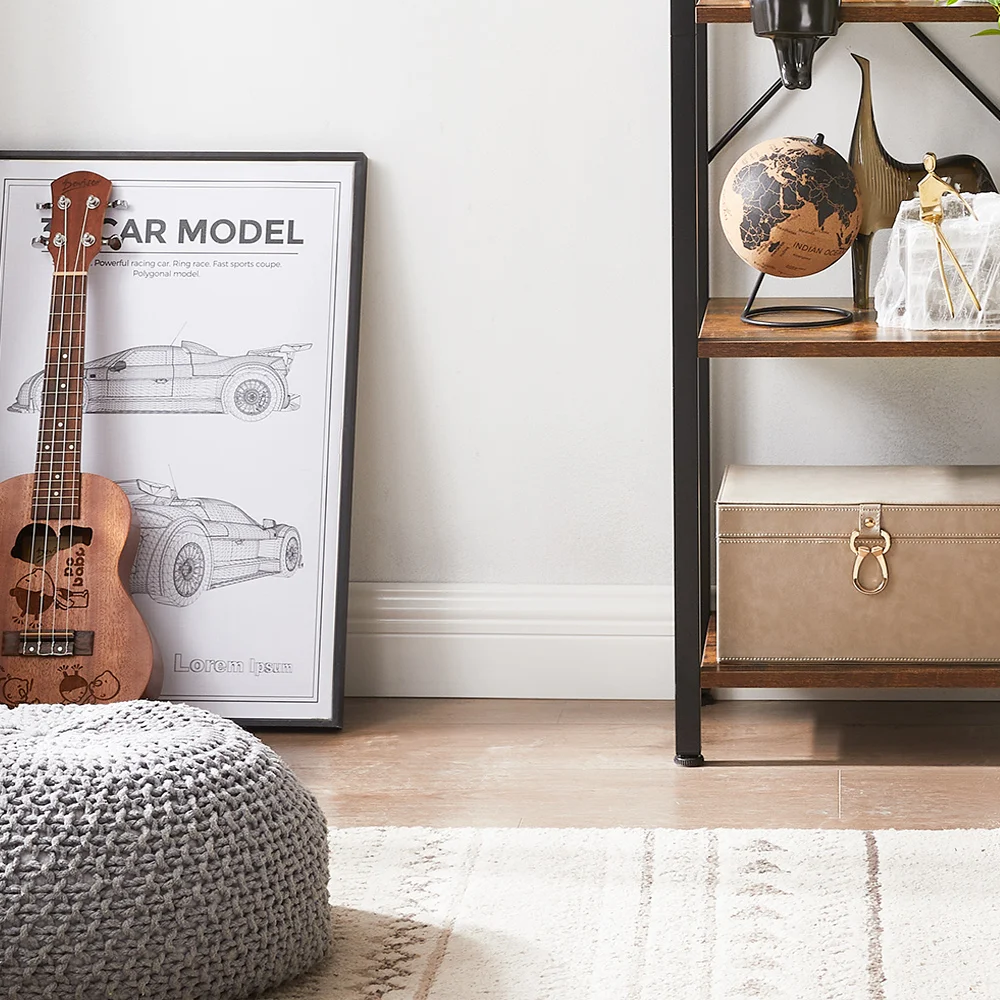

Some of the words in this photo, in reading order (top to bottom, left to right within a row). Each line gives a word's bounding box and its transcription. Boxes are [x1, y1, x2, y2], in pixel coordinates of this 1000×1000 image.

[178, 218, 304, 244] MODEL
[793, 241, 821, 255] INDIAN
[94, 259, 129, 268] Powerful
[131, 260, 155, 269] racing
[157, 260, 171, 268] car.
[172, 260, 191, 269] Ring
[213, 260, 228, 268] Fast
[230, 260, 254, 269] sports
[255, 261, 282, 269] coupe.
[132, 269, 171, 278] Polygonal
[173, 270, 200, 278] model.
[173, 653, 245, 674] Lorem
[249, 657, 293, 677] Ipsum
